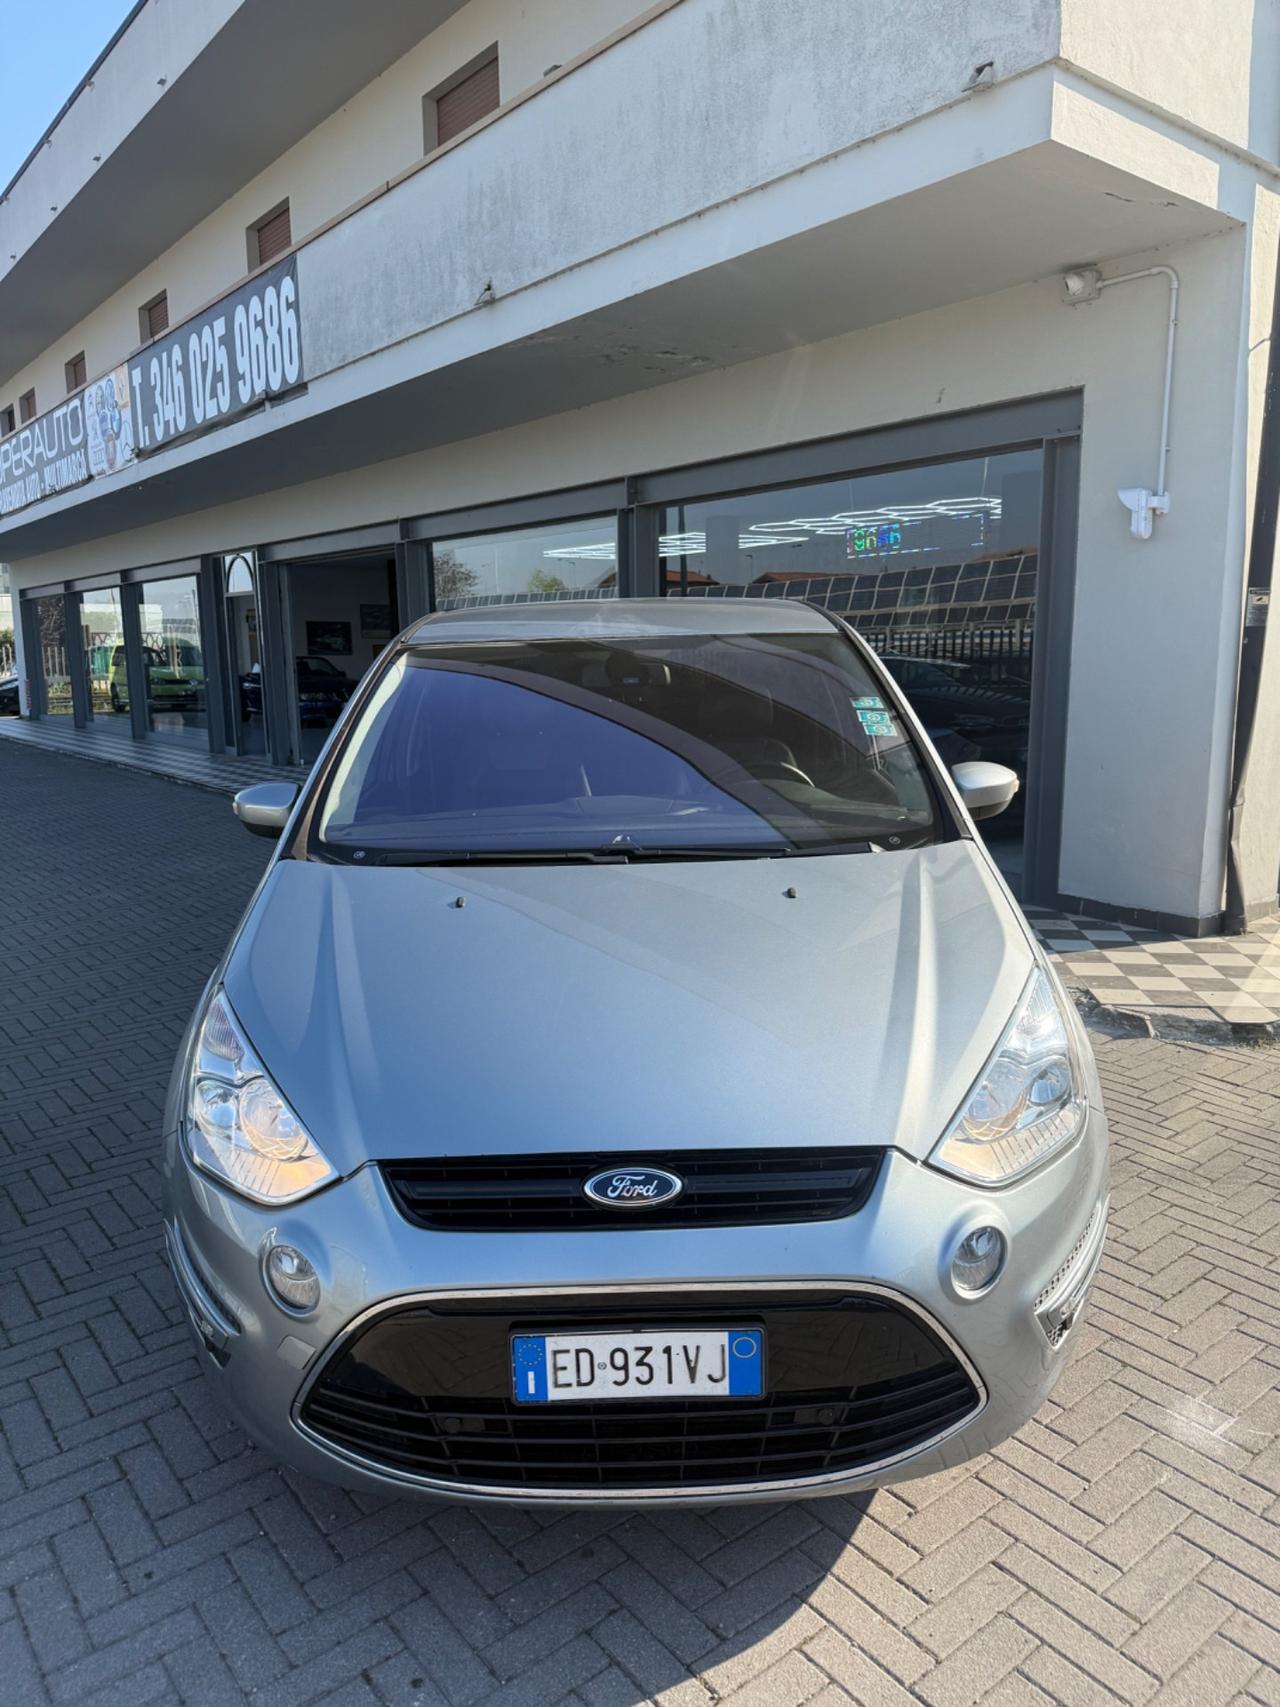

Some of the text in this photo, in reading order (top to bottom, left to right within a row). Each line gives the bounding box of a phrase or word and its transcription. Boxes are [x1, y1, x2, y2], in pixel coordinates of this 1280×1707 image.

[150, 344, 187, 441] 346
[189, 317, 230, 425] 025
[234, 275, 299, 404] 9686
[0, 398, 83, 488] PERAUTO
[606, 1174, 658, 1199] Ford
